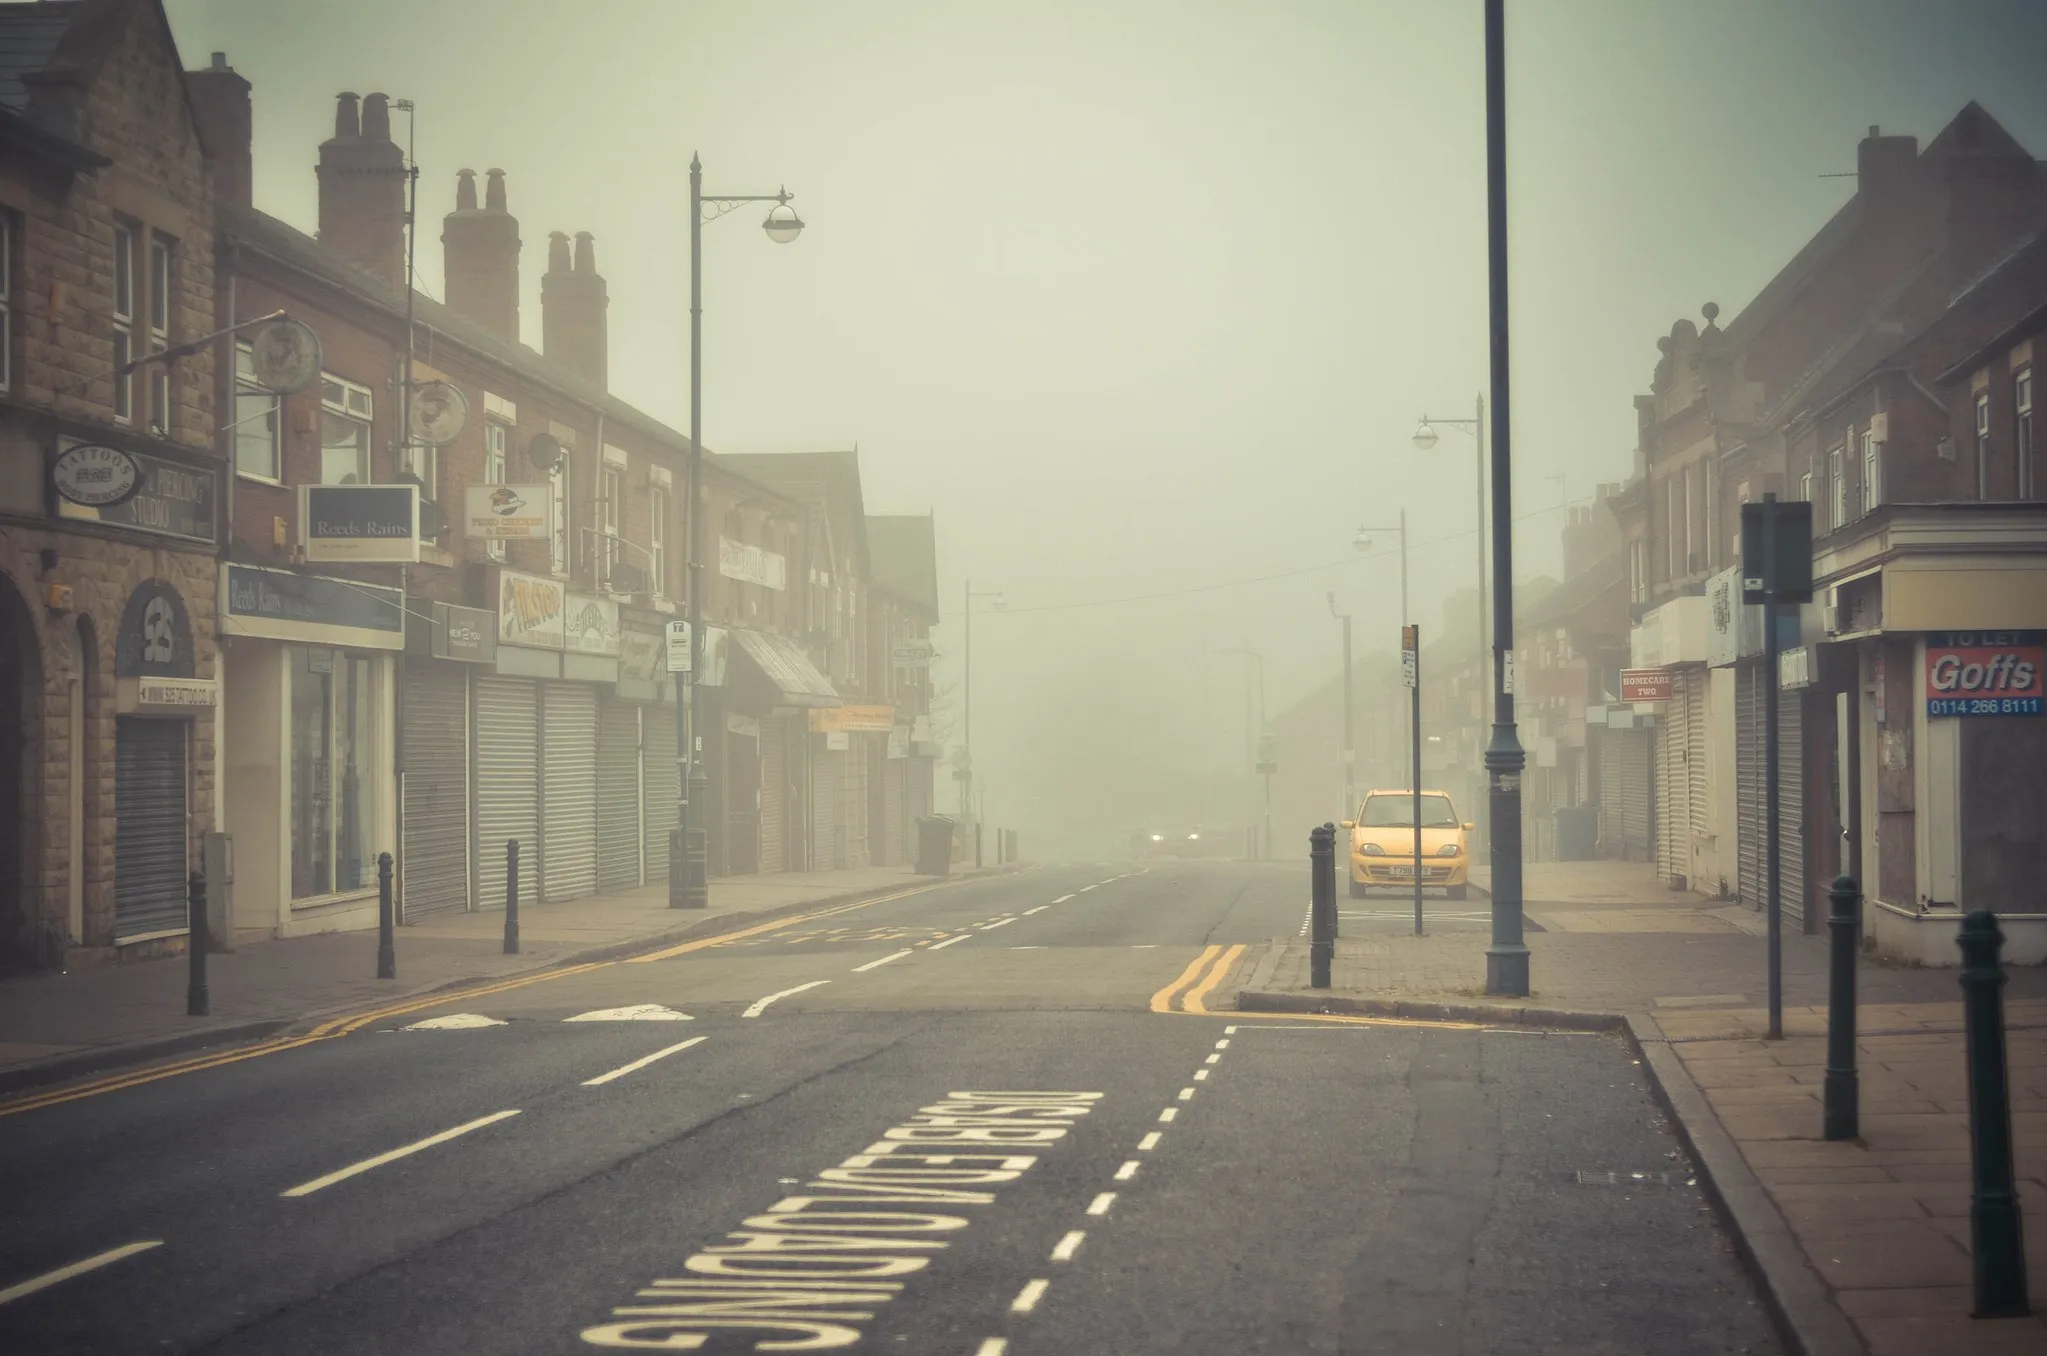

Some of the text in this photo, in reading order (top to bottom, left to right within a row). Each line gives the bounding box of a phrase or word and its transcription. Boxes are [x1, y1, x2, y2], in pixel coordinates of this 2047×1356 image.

[58, 448, 133, 475] TATTOOS
[131, 495, 170, 528] STUDIO
[317, 520, 408, 536] Reeds Rains
[231, 579, 257, 610] Reeds
[258, 582, 282, 612] Rains
[1945, 632, 2021, 646] TO LET
[1930, 653, 2035, 691] Goffs
[1622, 675, 1670, 686] HOMECARE
[1637, 687, 1657, 696] TWO
[1930, 698, 2037, 714] 0114 266 8111
